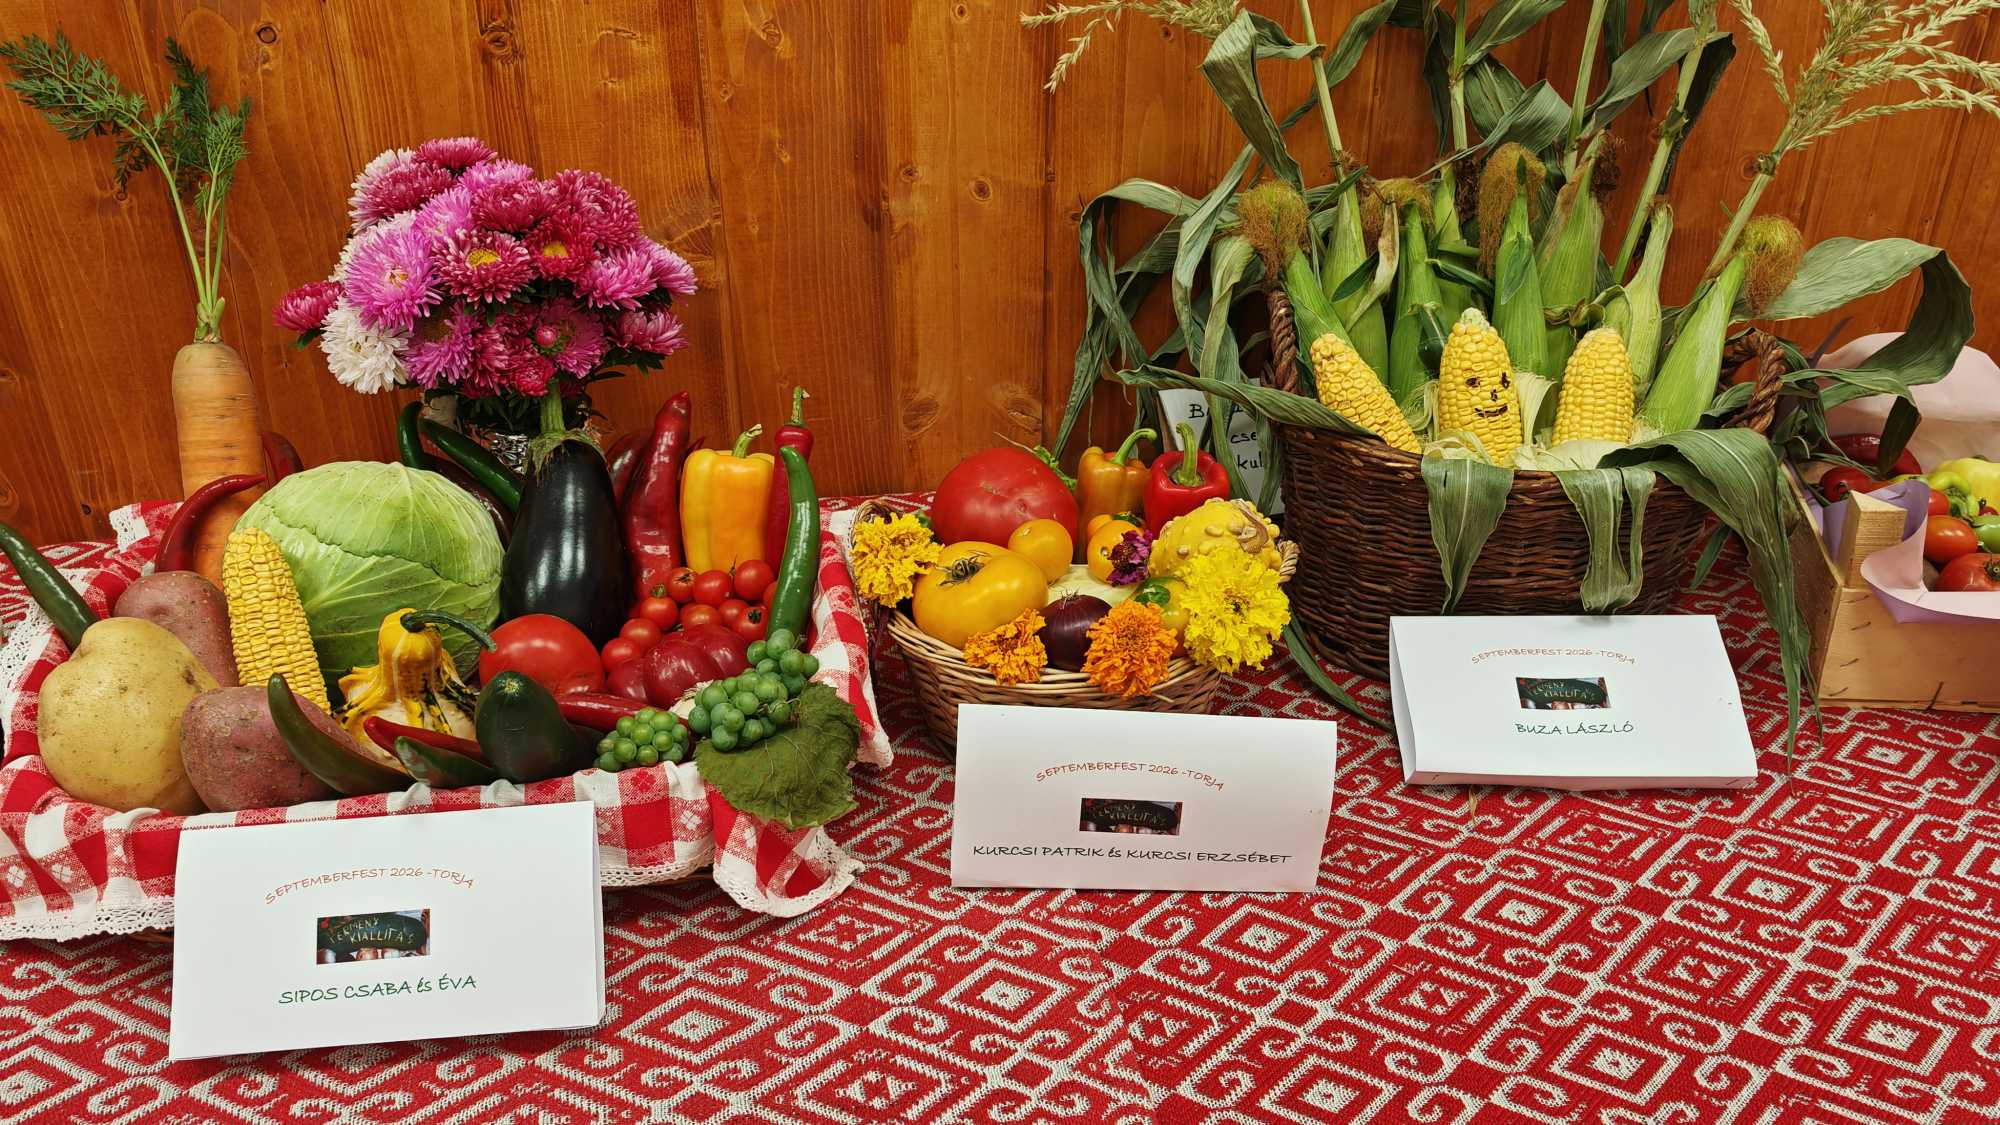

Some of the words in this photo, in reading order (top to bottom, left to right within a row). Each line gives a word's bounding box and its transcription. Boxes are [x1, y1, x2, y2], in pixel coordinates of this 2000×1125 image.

[1472, 648, 1563, 665] SEPTEMBERFEST
[1565, 648, 1593, 656] 2026
[1514, 722, 1563, 735] BUZA
[1566, 720, 1634, 735] LÁSZLÓ
[1035, 761, 1147, 783] SEPTEMBERFEST
[1148, 763, 1179, 776] 2026
[972, 845, 1038, 857] KURCSI
[1042, 846, 1104, 858] PATRIK
[1107, 846, 1122, 859] és
[1126, 849, 1192, 861] KURCSI
[1196, 851, 1293, 865] ERZSÉBET
[264, 867, 388, 905] SEPTEMBERFEST
[389, 866, 424, 878] 2026
[278, 987, 339, 1004] SIPOS
[344, 980, 413, 998] CSABA
[416, 976, 433, 993] és
[438, 973, 478, 991] ÉVA
